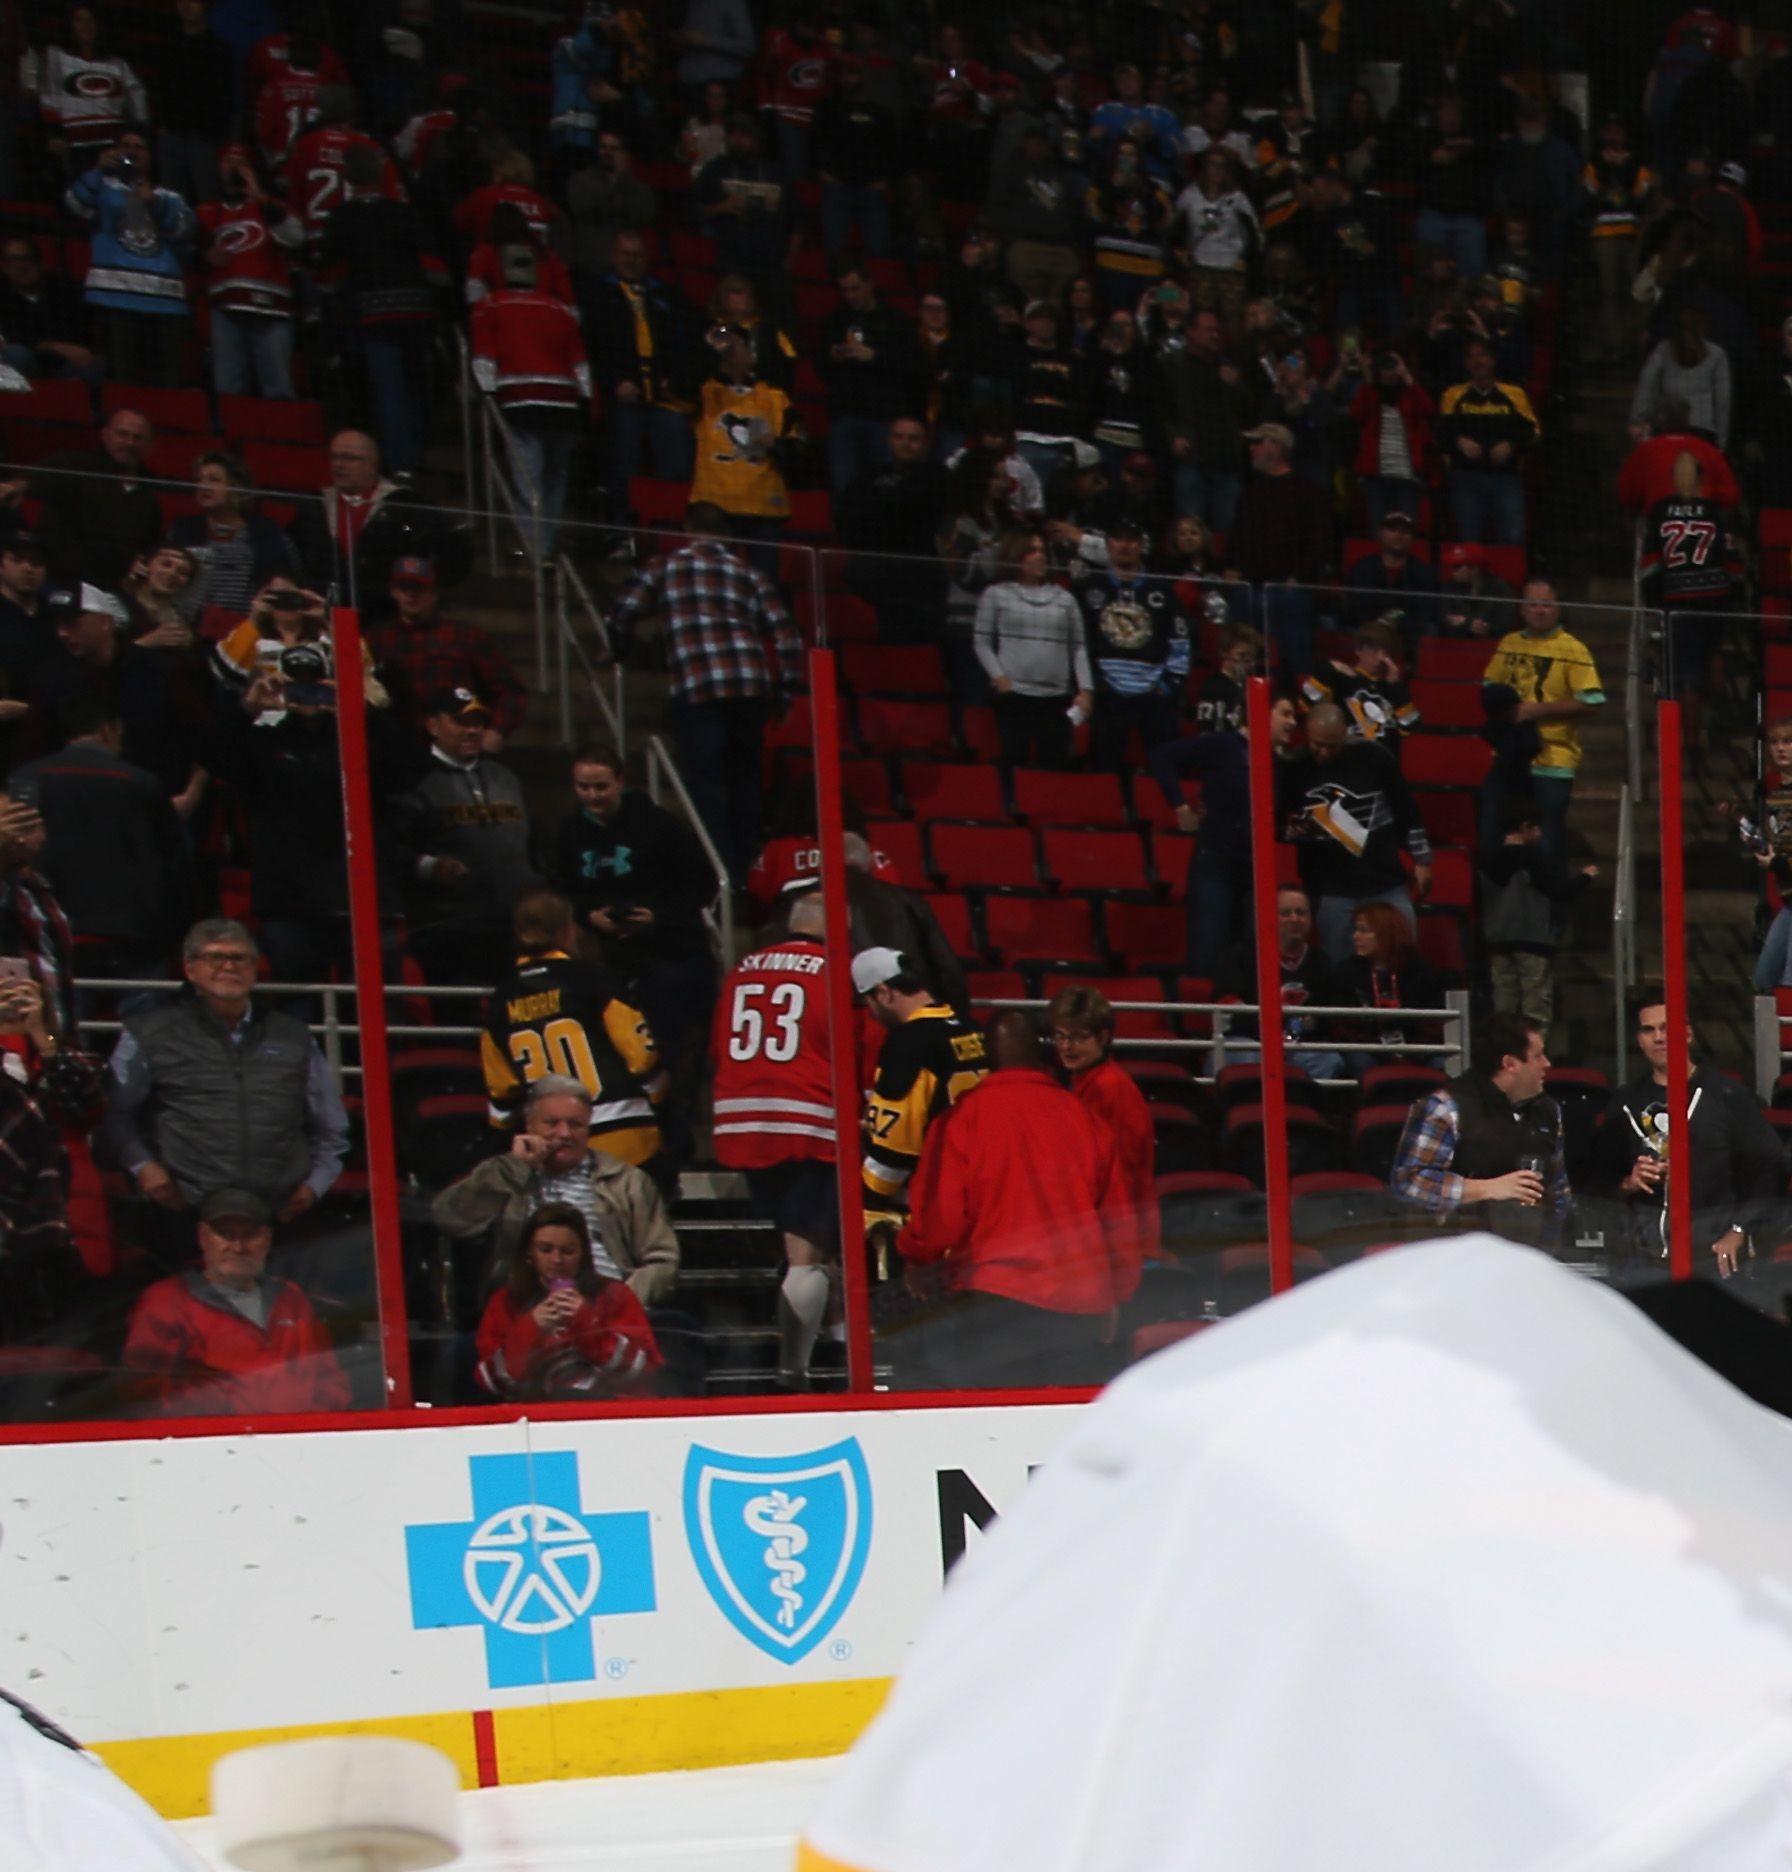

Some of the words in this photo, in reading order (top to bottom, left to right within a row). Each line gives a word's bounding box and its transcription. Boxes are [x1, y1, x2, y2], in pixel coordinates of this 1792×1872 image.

[1659, 519, 1717, 568] 27
[738, 952, 826, 976] SKINNER
[506, 988, 562, 1024] MURRAY
[727, 981, 806, 1063] 53
[508, 1016, 603, 1101] 30
